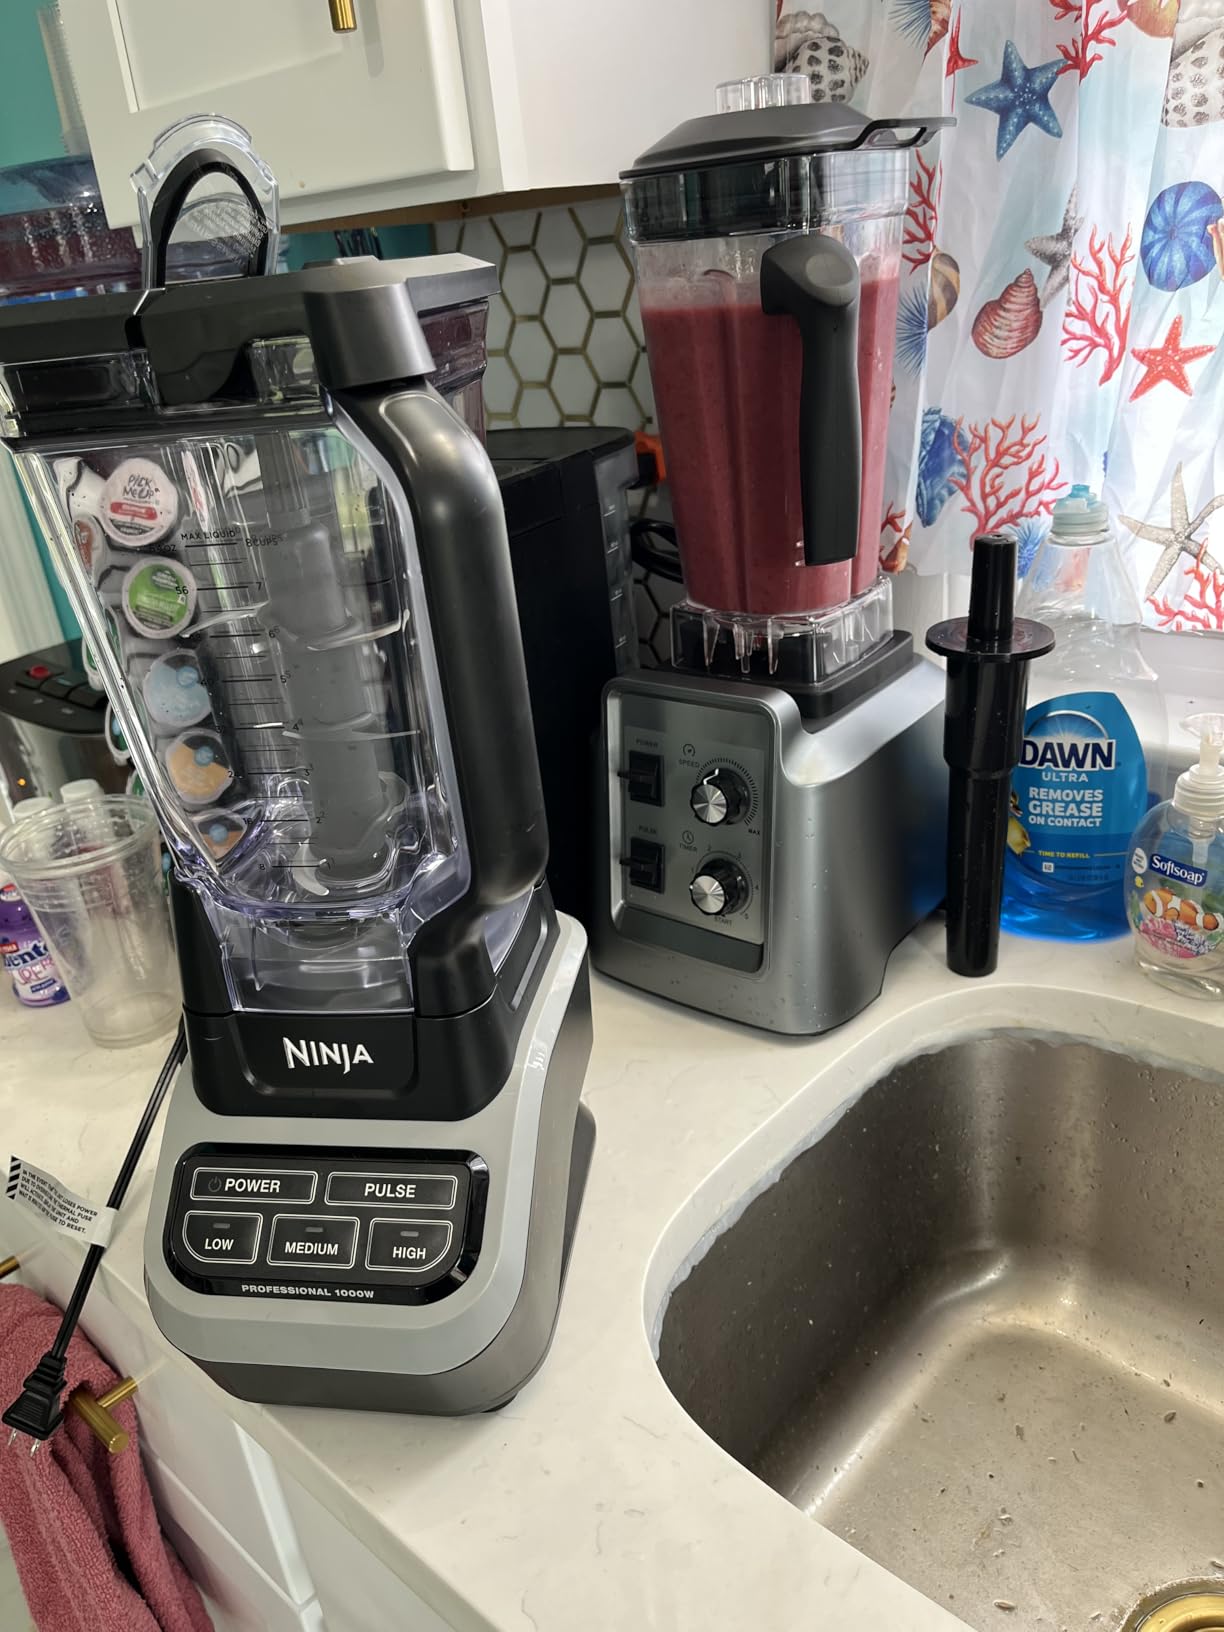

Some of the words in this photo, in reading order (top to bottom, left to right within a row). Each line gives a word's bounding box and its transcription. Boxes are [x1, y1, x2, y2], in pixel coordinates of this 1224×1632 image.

[181, 532, 201, 541] MAX
[203, 530, 236, 540] LIQUID
[175, 586, 189, 595] 56
[1020, 740, 1113, 769] DAWN
[1042, 772, 1088, 782] ULTRA
[1028, 787, 1104, 801] REMOVES
[1028, 801, 1103, 816] GREASE
[1028, 815, 1045, 825] ON
[1047, 817, 1103, 827] CONTACT
[1151, 855, 1203, 885] Softsoap
[282, 1037, 374, 1074] NINJA
[224, 1179, 281, 1193] POWER
[364, 1183, 416, 1198] PULSE
[77, 1204, 98, 1216] POWER
[66, 1215, 80, 1224] AND
[77, 1212, 92, 1222] FUSE
[204, 1238, 234, 1250] LOW
[284, 1242, 339, 1255] MEDIUM
[392, 1246, 426, 1259] HIGH
[241, 1284, 332, 1297] PROFESSIONAL
[334, 1287, 375, 1299] 1000W
